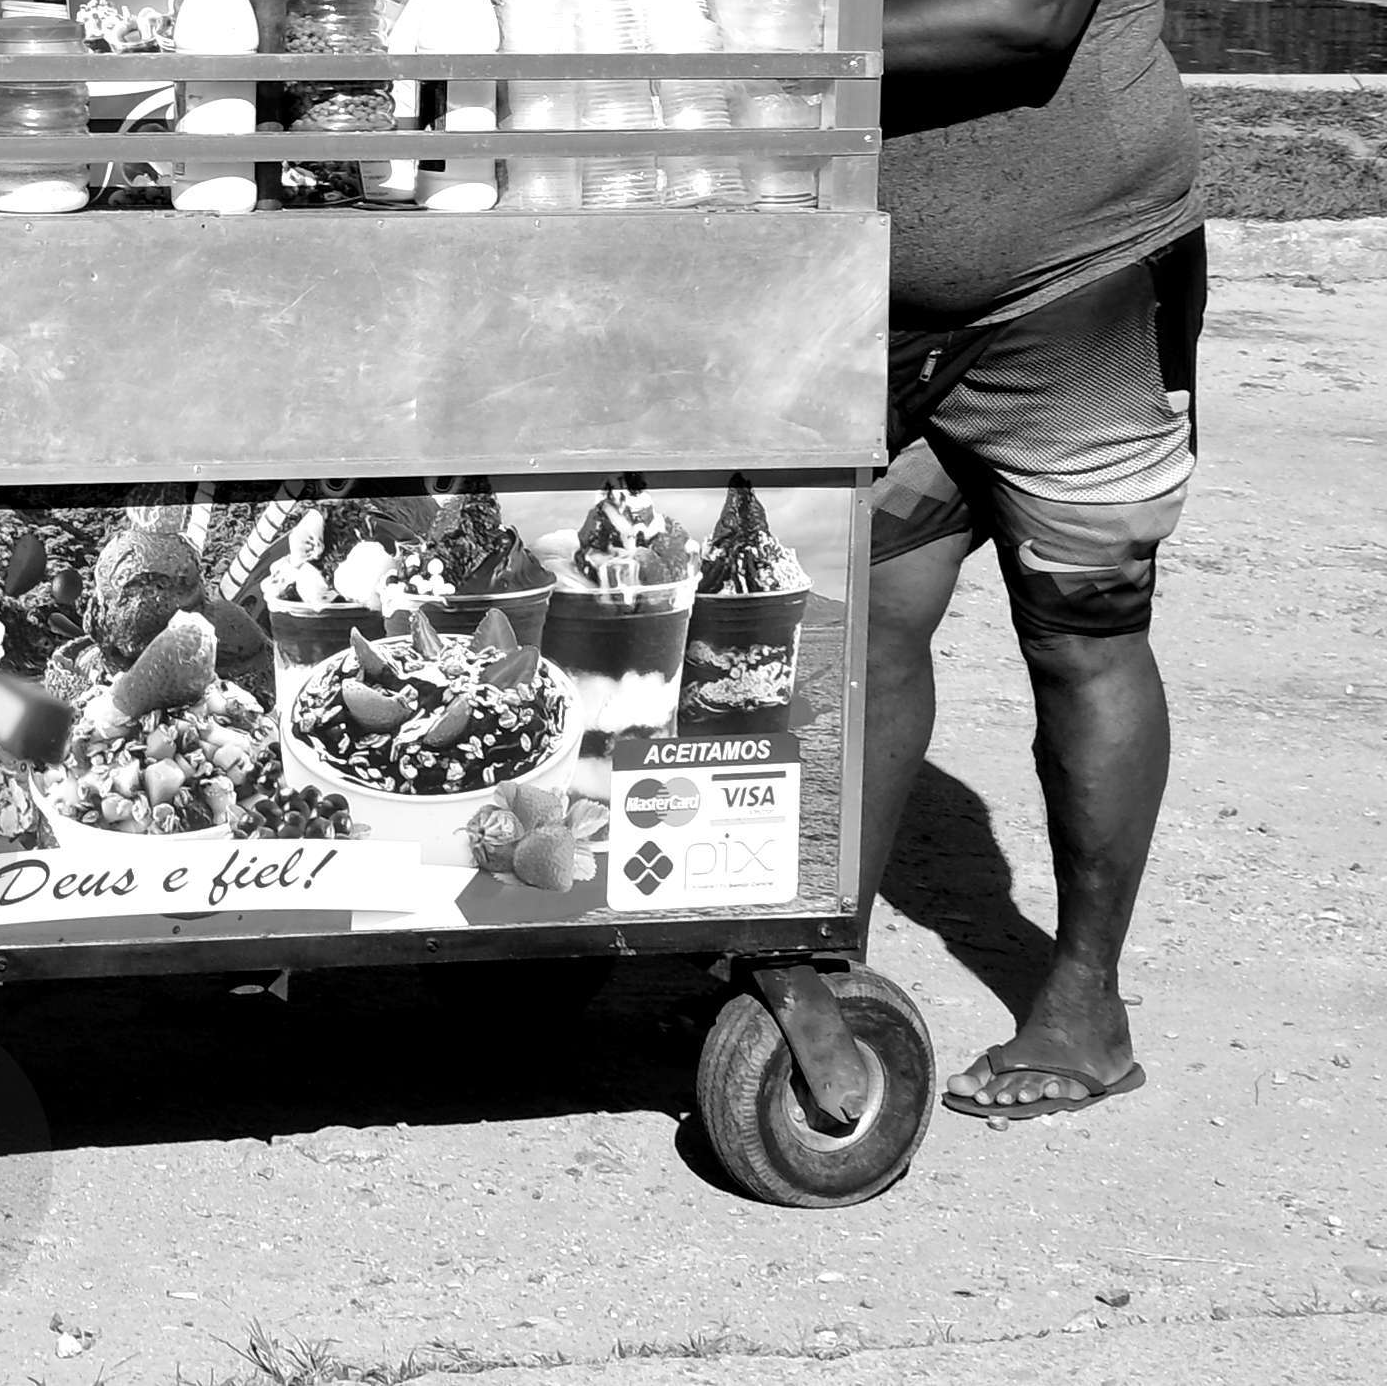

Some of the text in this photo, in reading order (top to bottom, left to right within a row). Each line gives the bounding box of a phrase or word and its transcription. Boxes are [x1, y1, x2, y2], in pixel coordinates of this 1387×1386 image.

[643, 739, 772, 765] ACEITAMOS
[721, 785, 776, 808] VISA
[162, 867, 189, 893] e
[208, 847, 338, 906] fiel!
